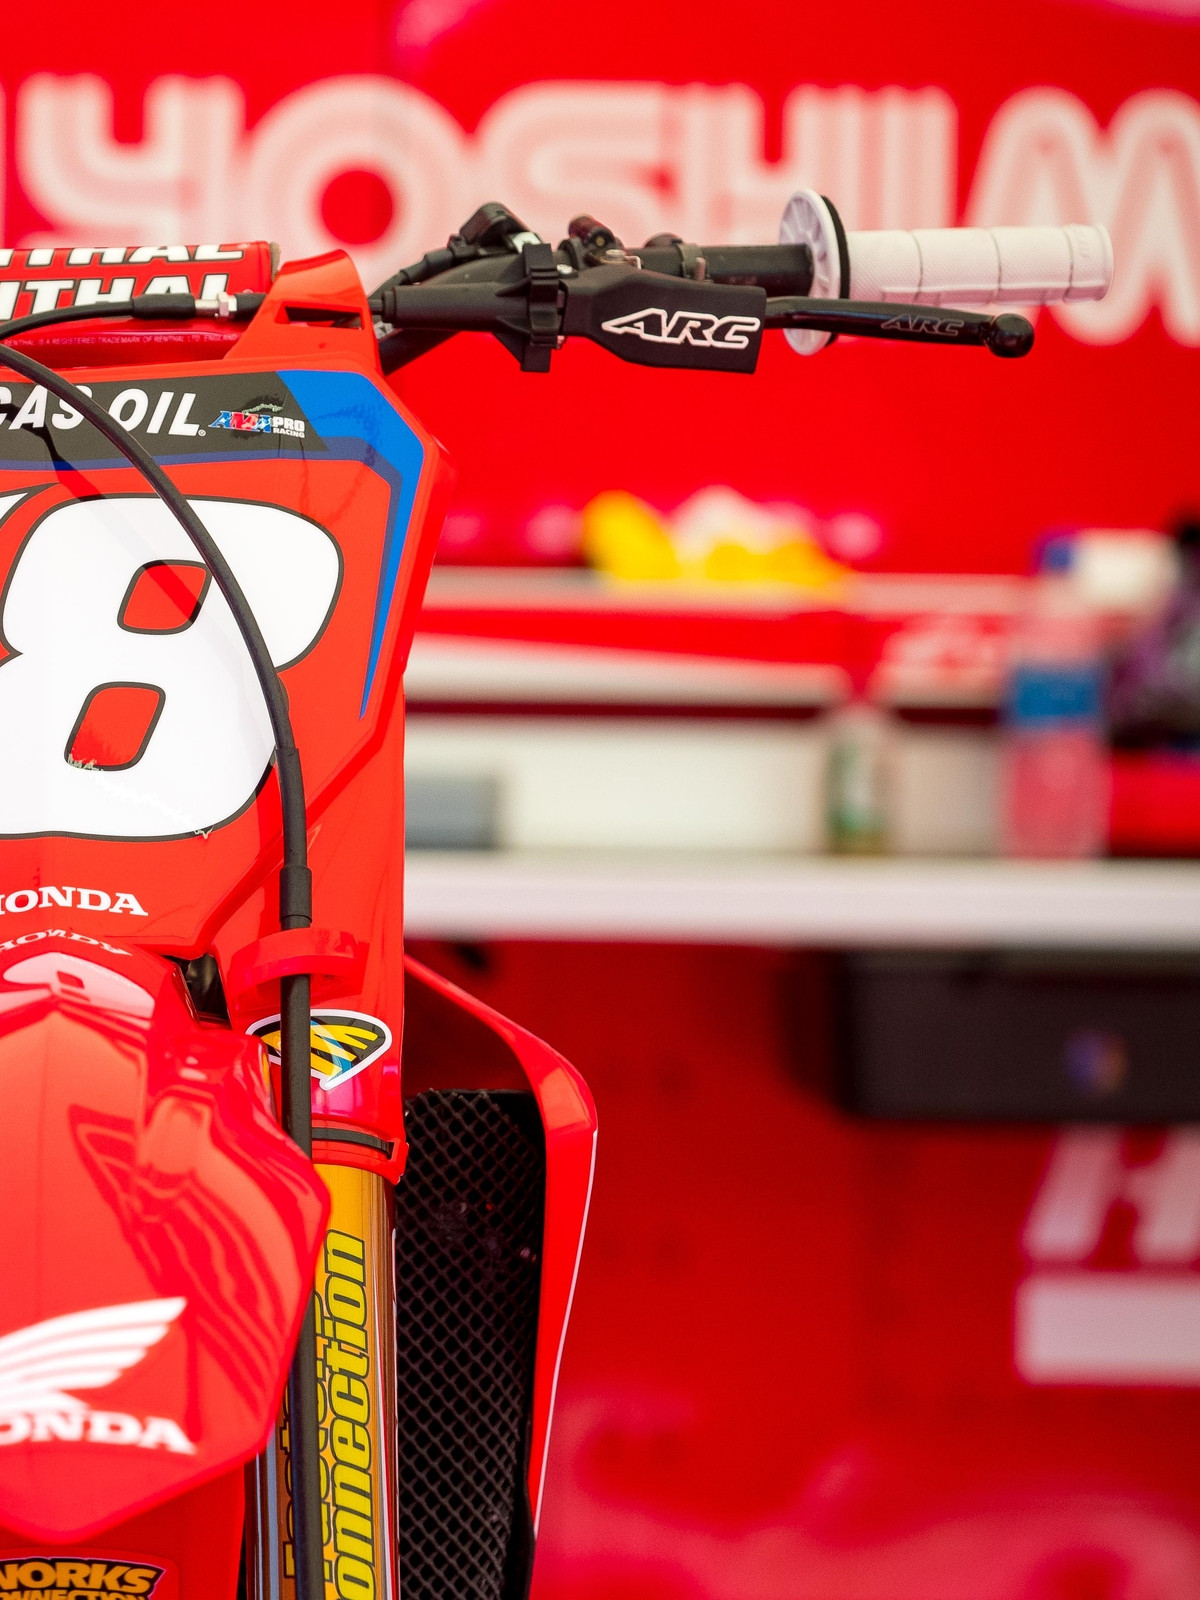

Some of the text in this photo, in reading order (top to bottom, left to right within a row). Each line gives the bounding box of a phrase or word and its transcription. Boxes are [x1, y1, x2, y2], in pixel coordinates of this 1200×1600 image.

[601, 307, 761, 349] ARC
[881, 313, 966, 337] ARC
[52, 337, 96, 345] REGISTERED
[99, 336, 141, 344] TRADEMARK
[154, 335, 185, 343] RENTHAL
[108, 388, 200, 437] OIL
[208, 411, 305, 433] AMA PRO
[273, 427, 305, 438] RACING
[324, 1229, 377, 1600] onnection
